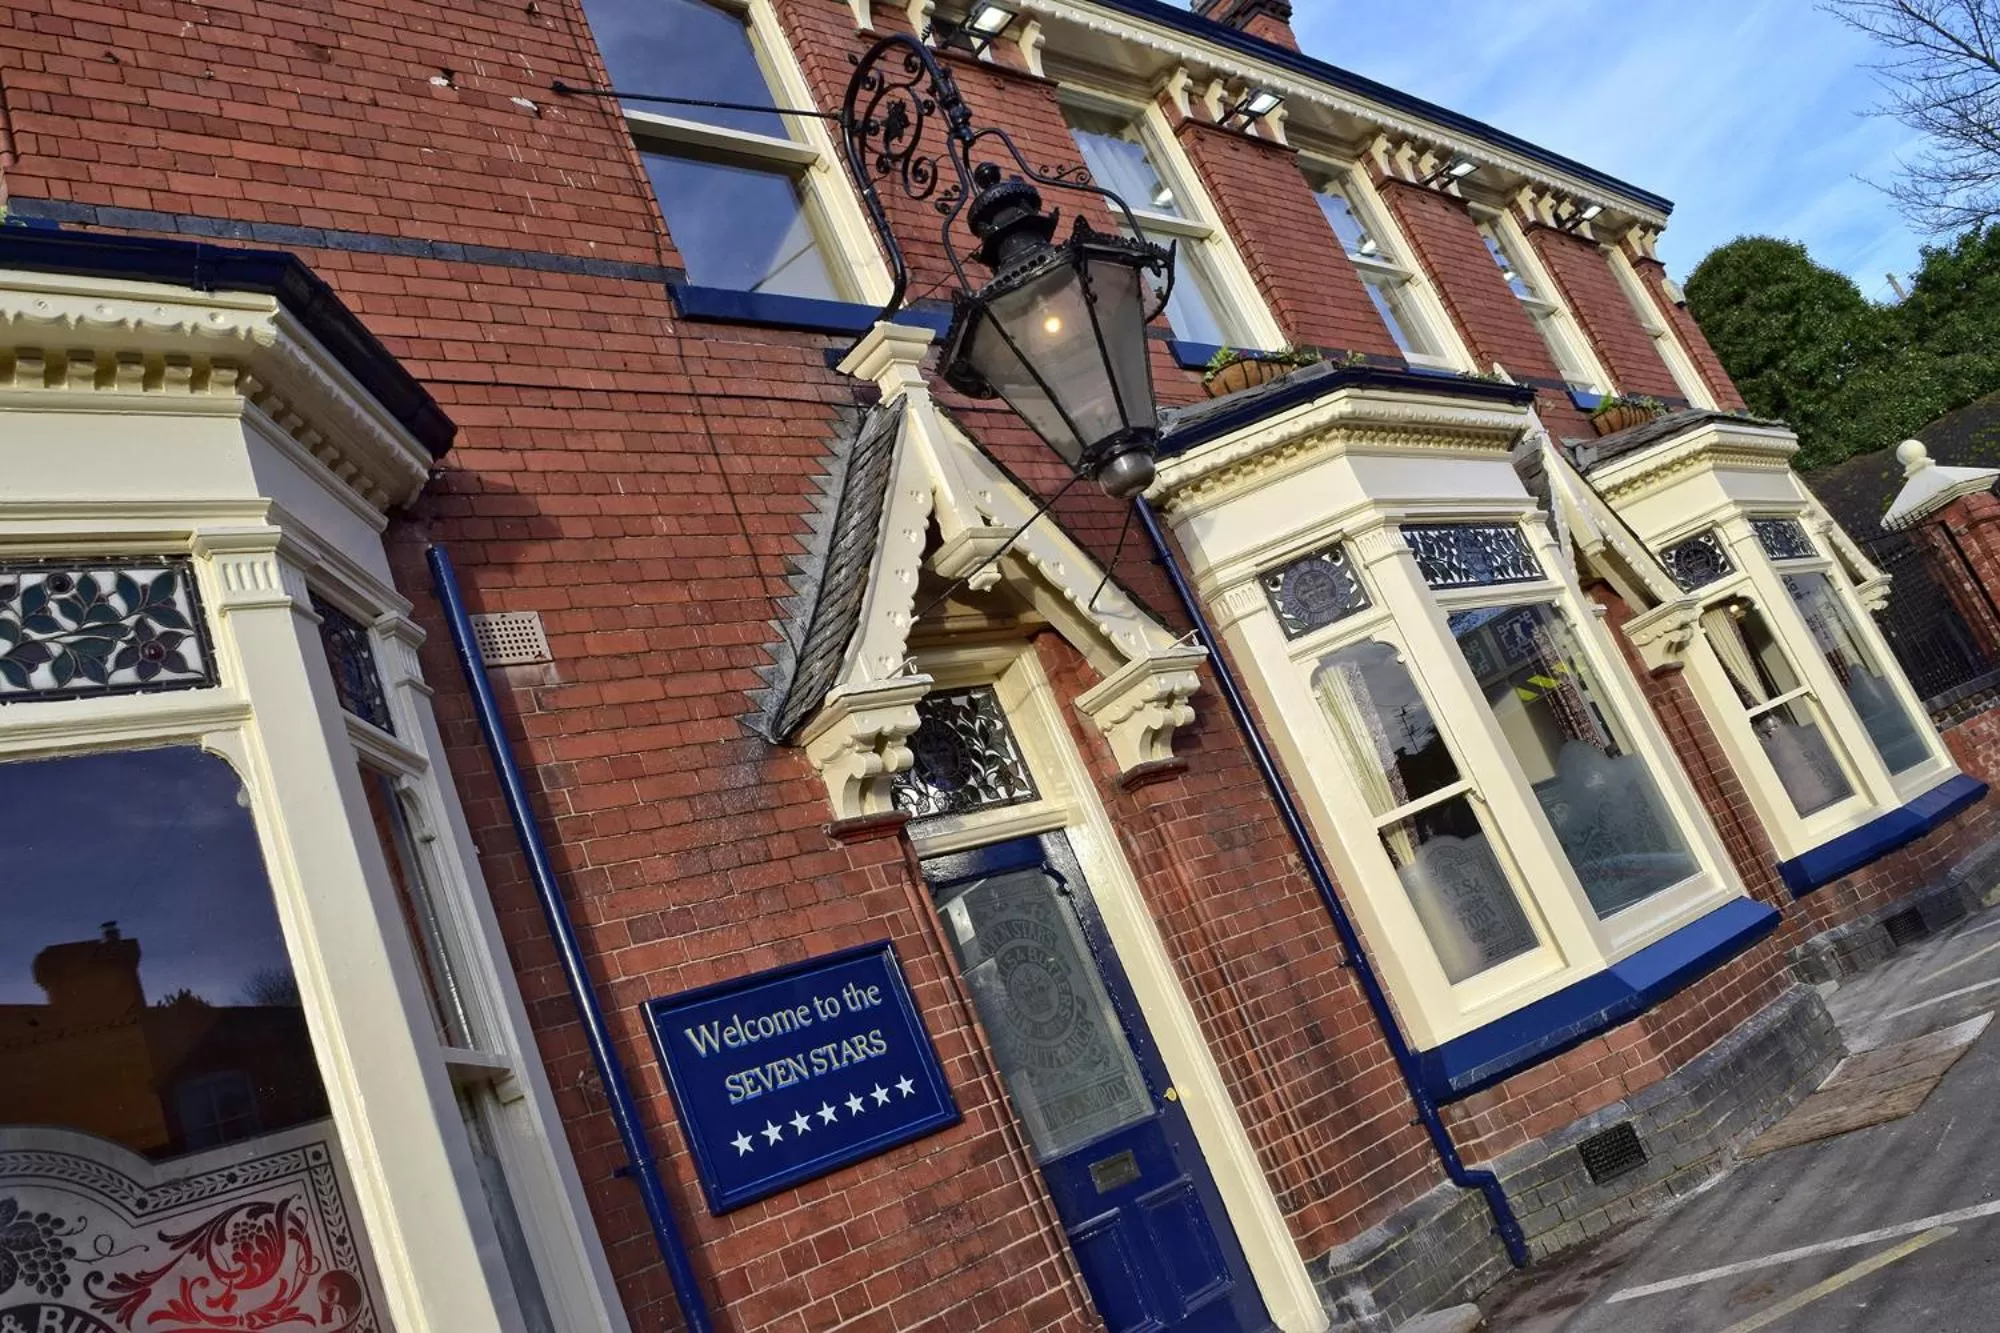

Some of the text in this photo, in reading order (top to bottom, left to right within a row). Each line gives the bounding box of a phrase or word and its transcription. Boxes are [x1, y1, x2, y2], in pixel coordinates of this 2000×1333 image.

[684, 981, 882, 1059] Welcome to the
[725, 1029, 887, 1105] SEVEN STARS
